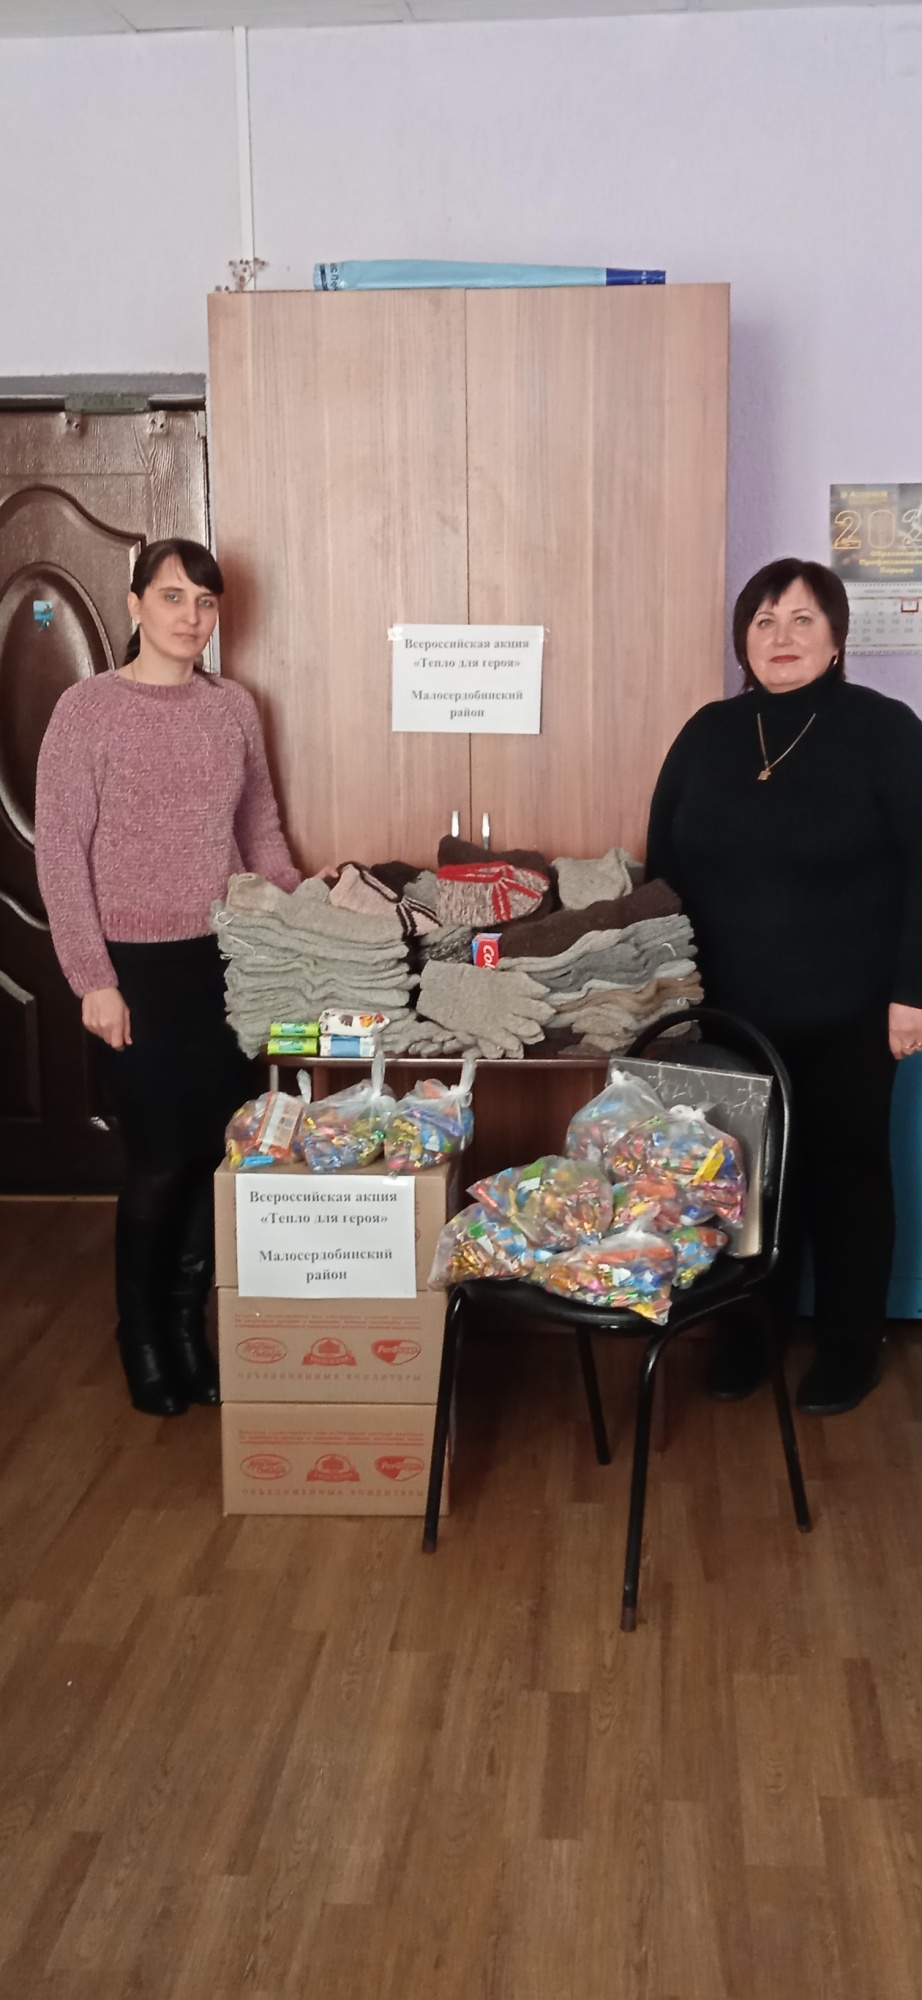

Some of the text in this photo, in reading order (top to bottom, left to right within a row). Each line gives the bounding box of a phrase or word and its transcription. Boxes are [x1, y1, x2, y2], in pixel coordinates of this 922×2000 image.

[404, 638, 529, 651] Всероссийская акция
[413, 657, 521, 670] «Тепло для героя»
[411, 690, 523, 702] Малосердобинский
[449, 707, 485, 719] район
[483, 944, 495, 969] Col
[249, 1191, 398, 1205] Всероссийская акция
[260, 1212, 388, 1226] «Тепло для героя»
[259, 1248, 393, 1263] Малосердобинский
[305, 1269, 348, 1283] район
